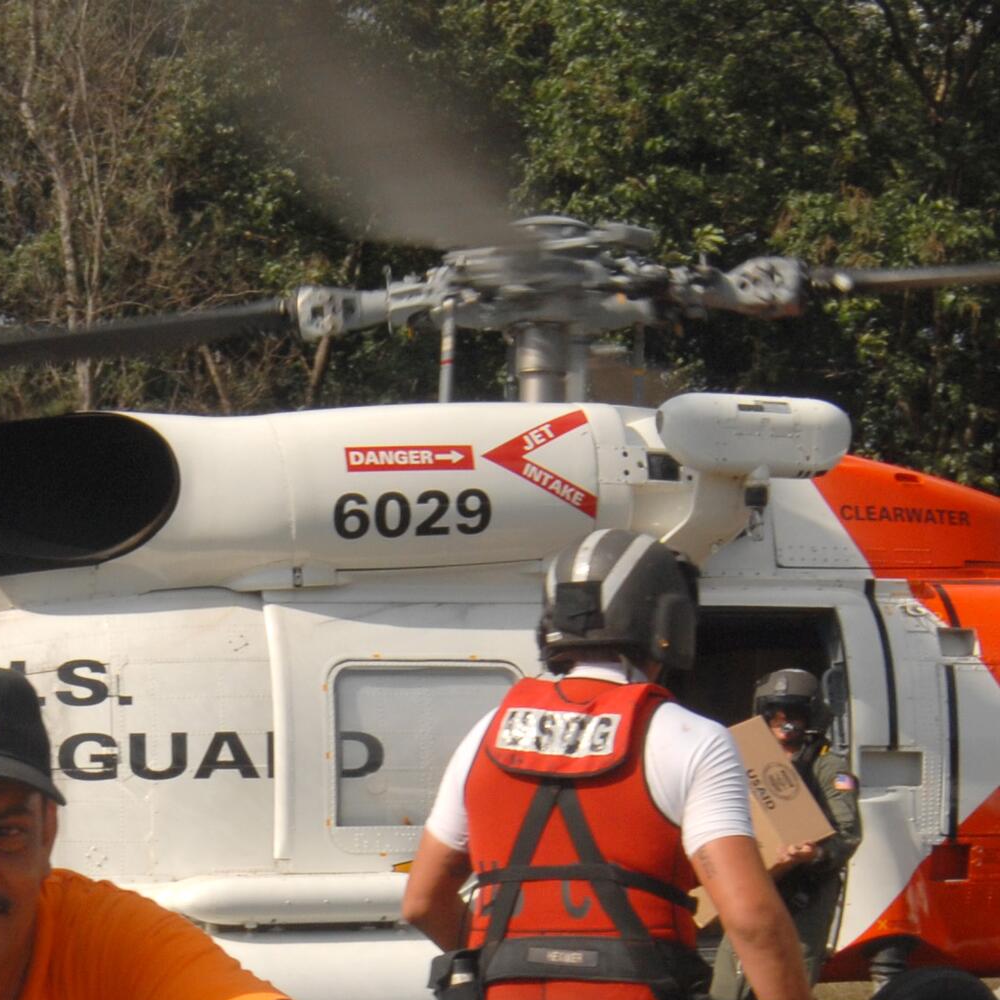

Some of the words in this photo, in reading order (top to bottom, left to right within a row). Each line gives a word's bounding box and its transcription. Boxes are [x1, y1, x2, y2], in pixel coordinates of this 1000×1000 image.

[523, 424, 555, 451] JET
[349, 450, 434, 465] DANGER
[523, 463, 586, 507] INTAKE
[333, 488, 493, 540] 6029
[839, 504, 971, 527] CLEARWATER
[746, 768, 776, 811] USAID
